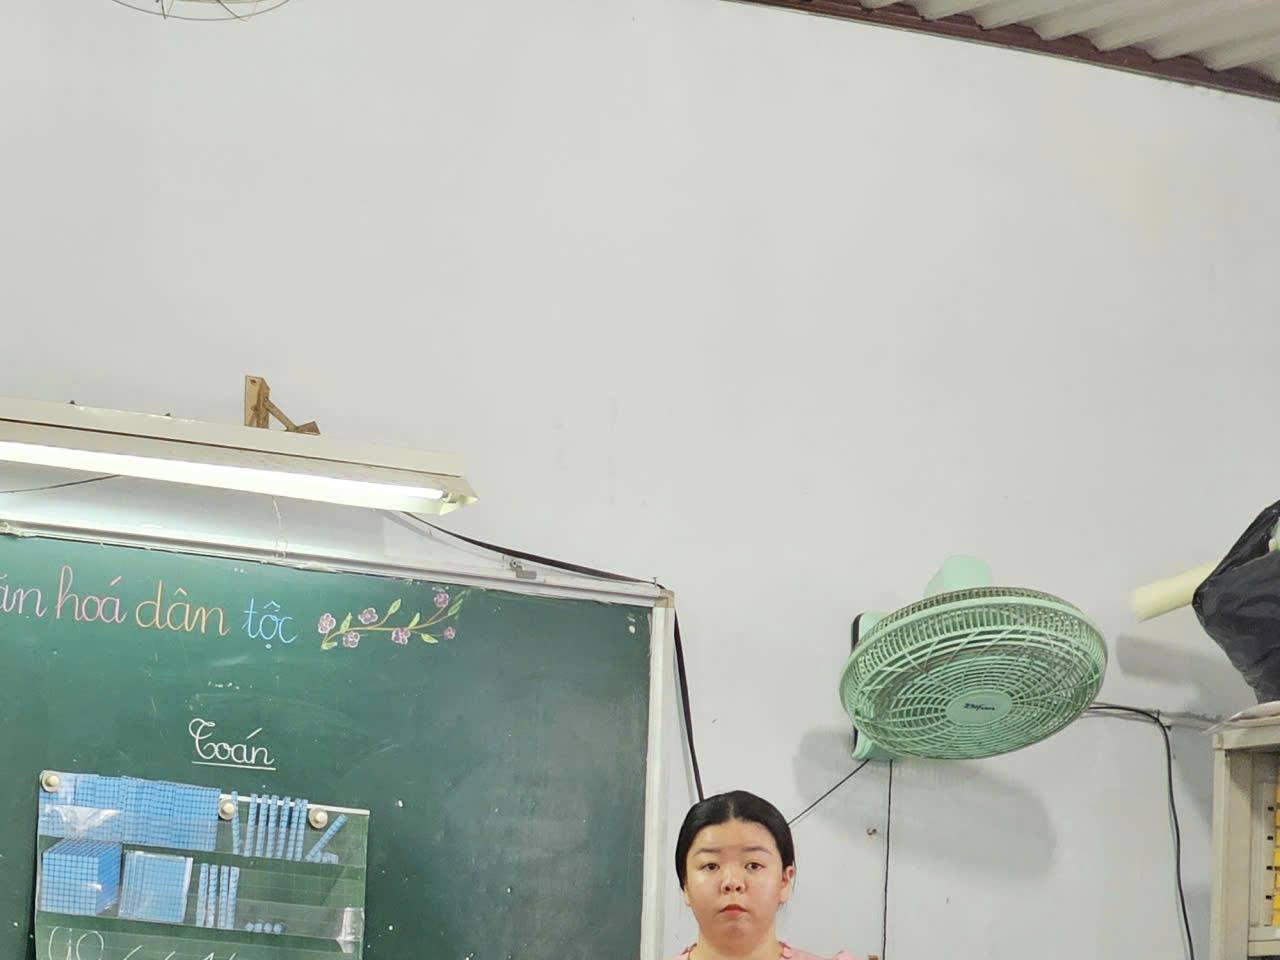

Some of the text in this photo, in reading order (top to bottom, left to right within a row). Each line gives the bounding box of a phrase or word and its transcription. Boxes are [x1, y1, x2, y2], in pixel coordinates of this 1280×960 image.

[55, 565, 128, 624] hoá
[135, 580, 231, 636] dân
[241, 598, 299, 649] tộc
[188, 718, 275, 765] Toán
